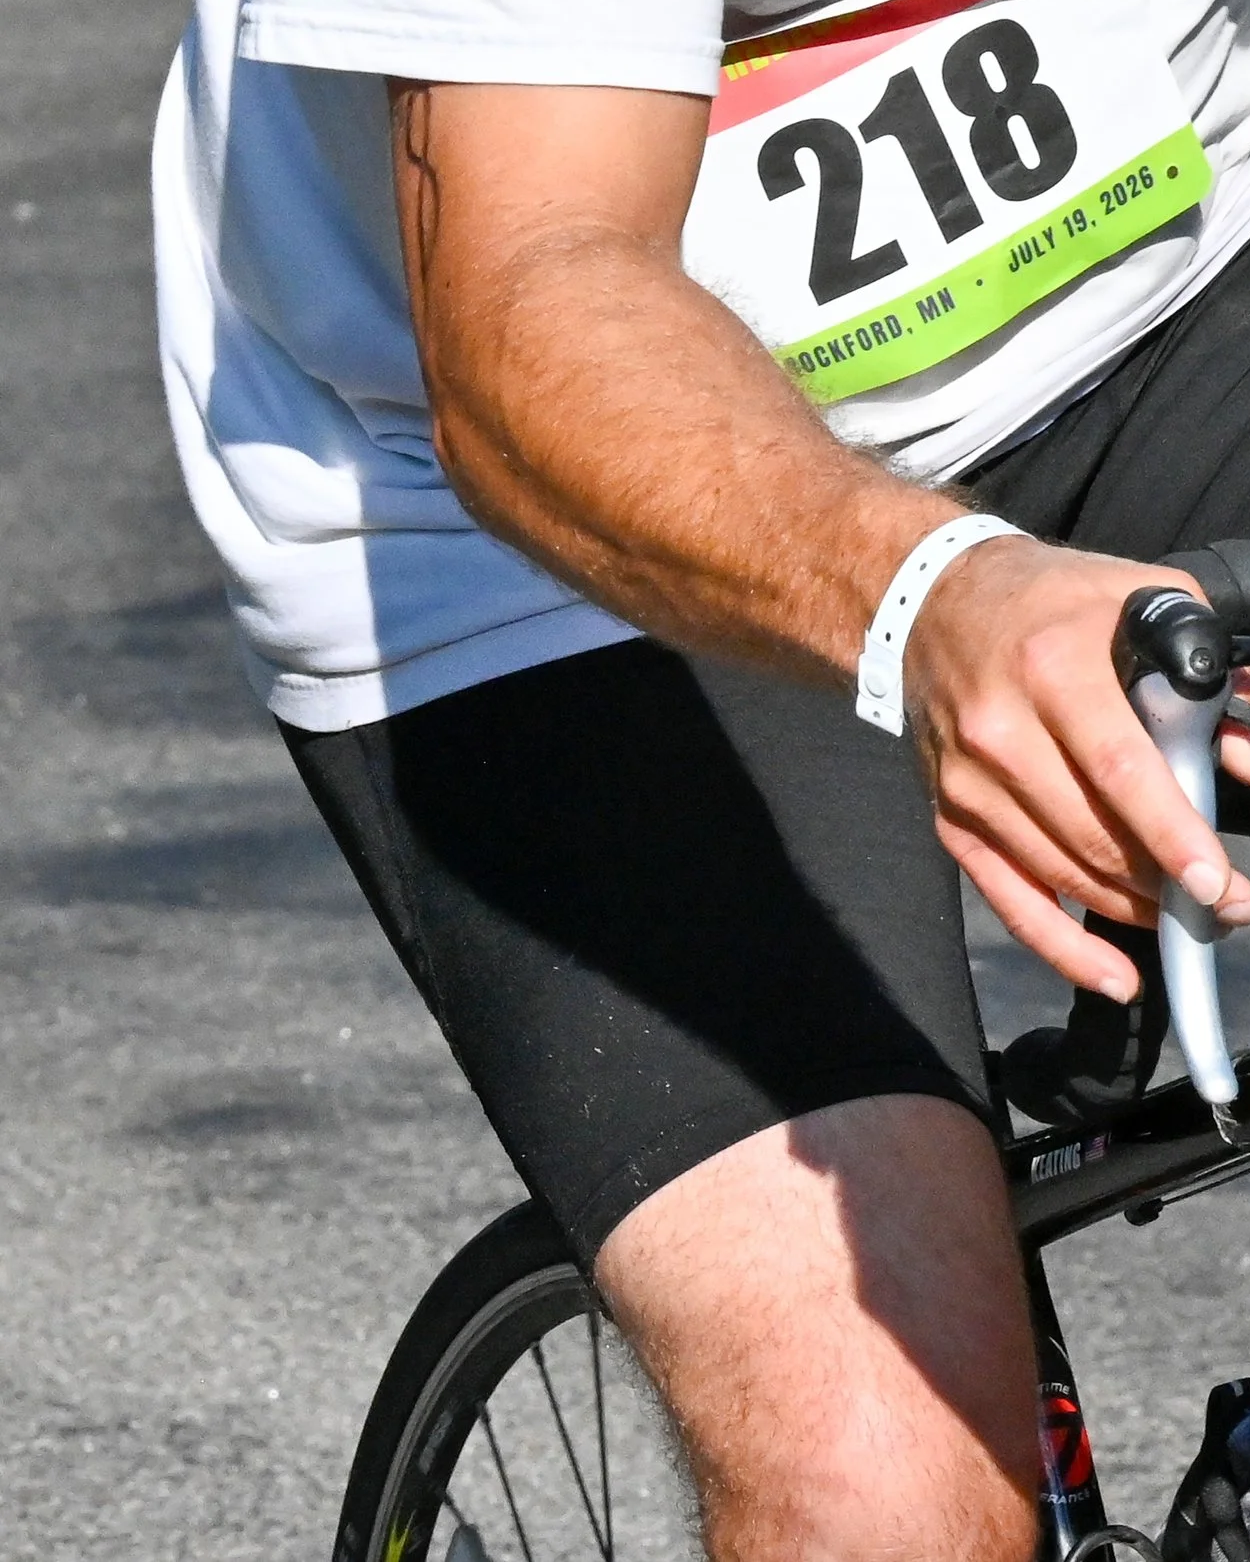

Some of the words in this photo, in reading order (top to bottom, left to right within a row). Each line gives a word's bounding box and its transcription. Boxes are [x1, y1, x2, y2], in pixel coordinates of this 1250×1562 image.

[757, 18, 1078, 306] 218
[915, 287, 956, 324] MN
[1008, 226, 1055, 273] JULY
[1063, 208, 1096, 238] 19,
[1099, 165, 1154, 215] 2026
